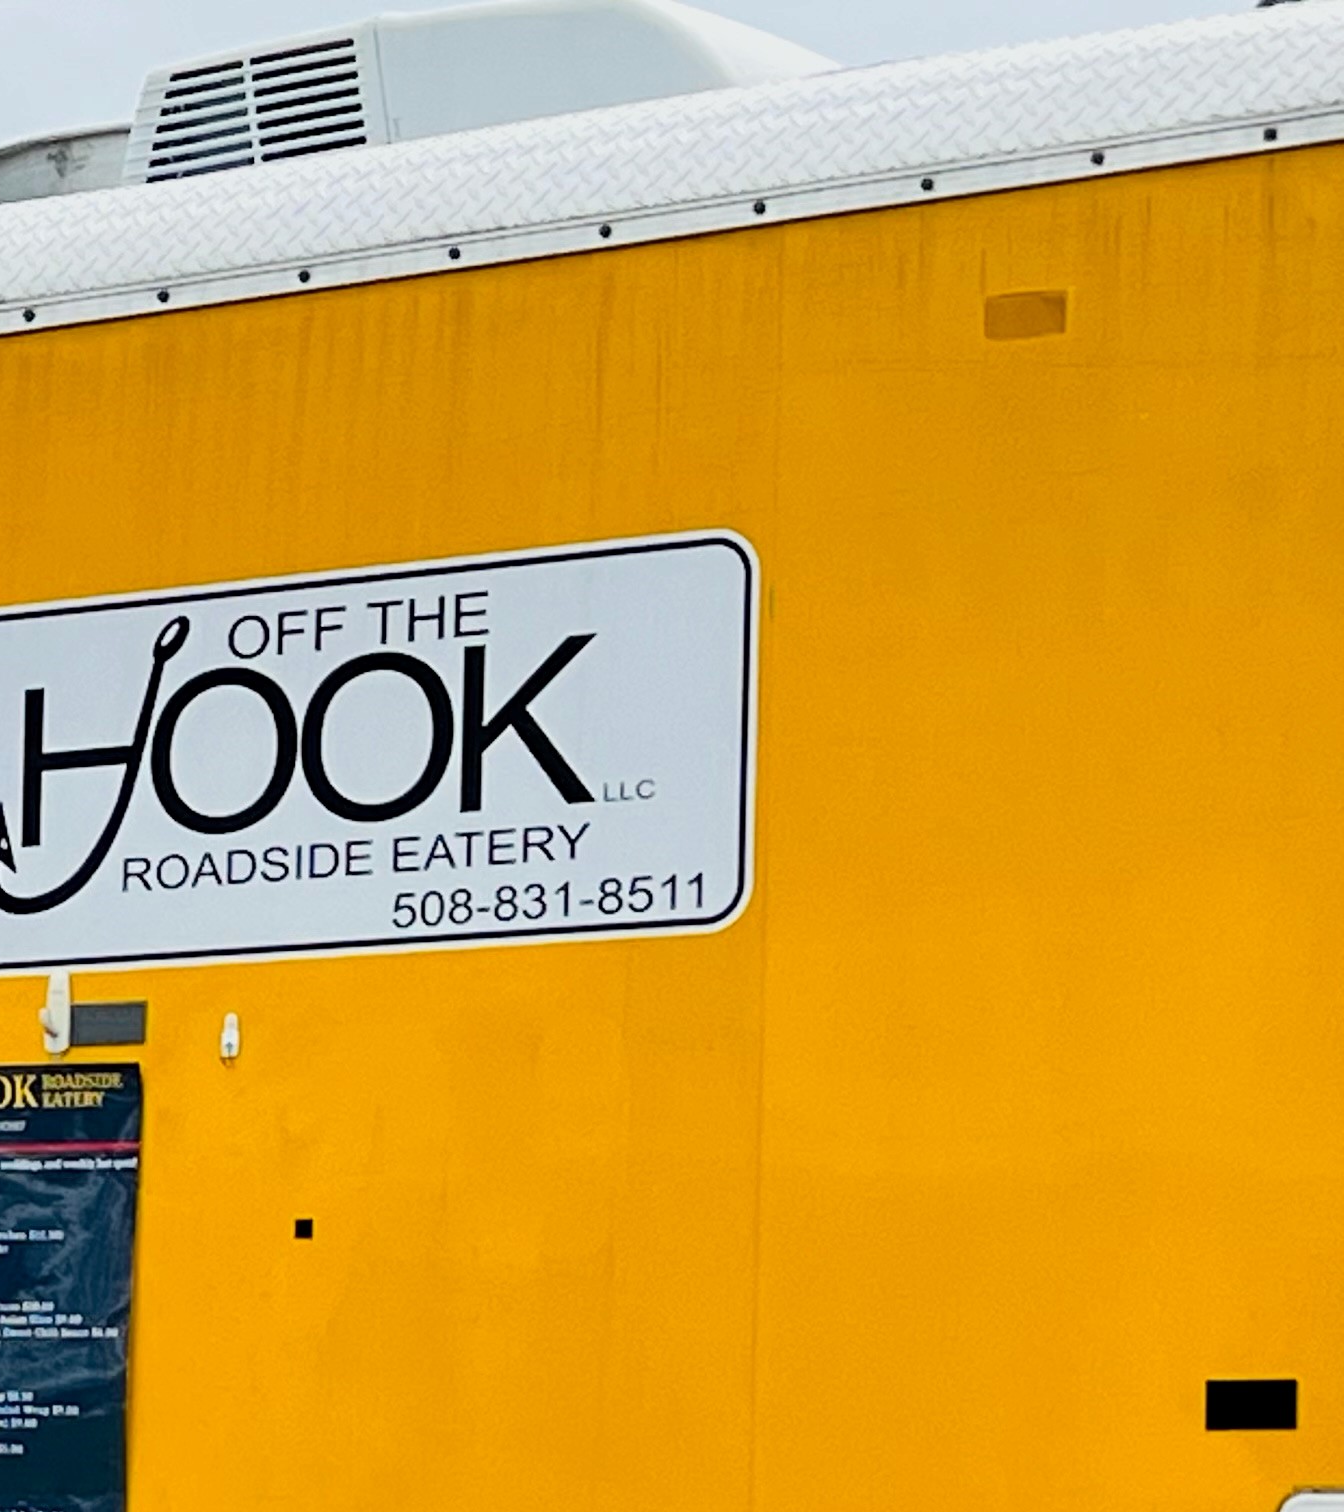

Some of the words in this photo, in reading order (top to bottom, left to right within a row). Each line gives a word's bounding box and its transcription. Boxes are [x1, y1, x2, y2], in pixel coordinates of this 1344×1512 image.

[228, 606, 346, 659] OFF
[367, 591, 489, 644] THE
[602, 779, 655, 802] LLC
[122, 841, 372, 892] ROADSIDE
[393, 823, 590, 872] EATERY
[393, 873, 703, 928] 508-831-8511
[42, 1074, 122, 1089] ROADSIDE
[42, 1092, 104, 1108] EATERY
